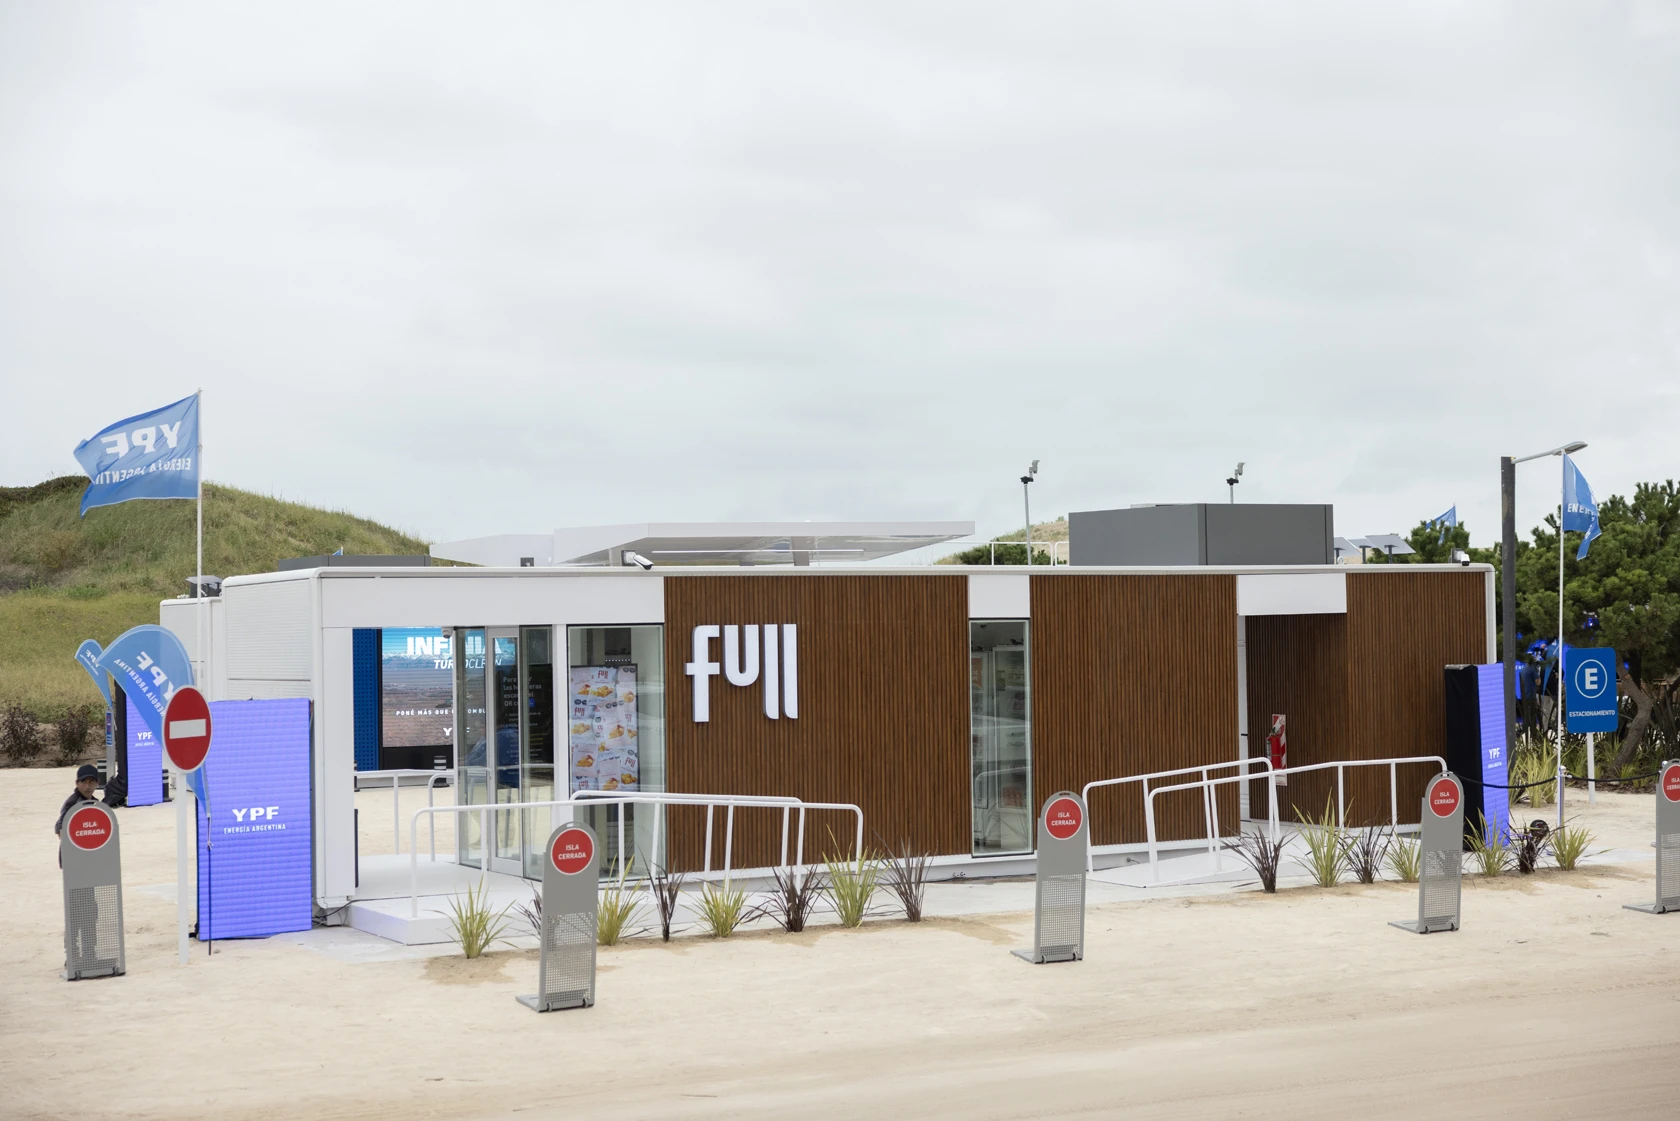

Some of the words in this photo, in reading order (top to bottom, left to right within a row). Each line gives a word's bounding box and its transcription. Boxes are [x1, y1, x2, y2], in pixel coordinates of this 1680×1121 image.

[685, 623, 798, 722] full
[1584, 667, 1599, 690] E
[1569, 709, 1616, 718] ESTACIONAMIENTO
[137, 731, 152, 741] YPF
[1488, 747, 1501, 760] YPF
[231, 806, 279, 822] YPF
[75, 829, 105, 837] CERRADA
[223, 825, 250, 835] ENERGÍA
[251, 823, 286, 832] ARGENTINA
[558, 852, 586, 860] CERRADA
